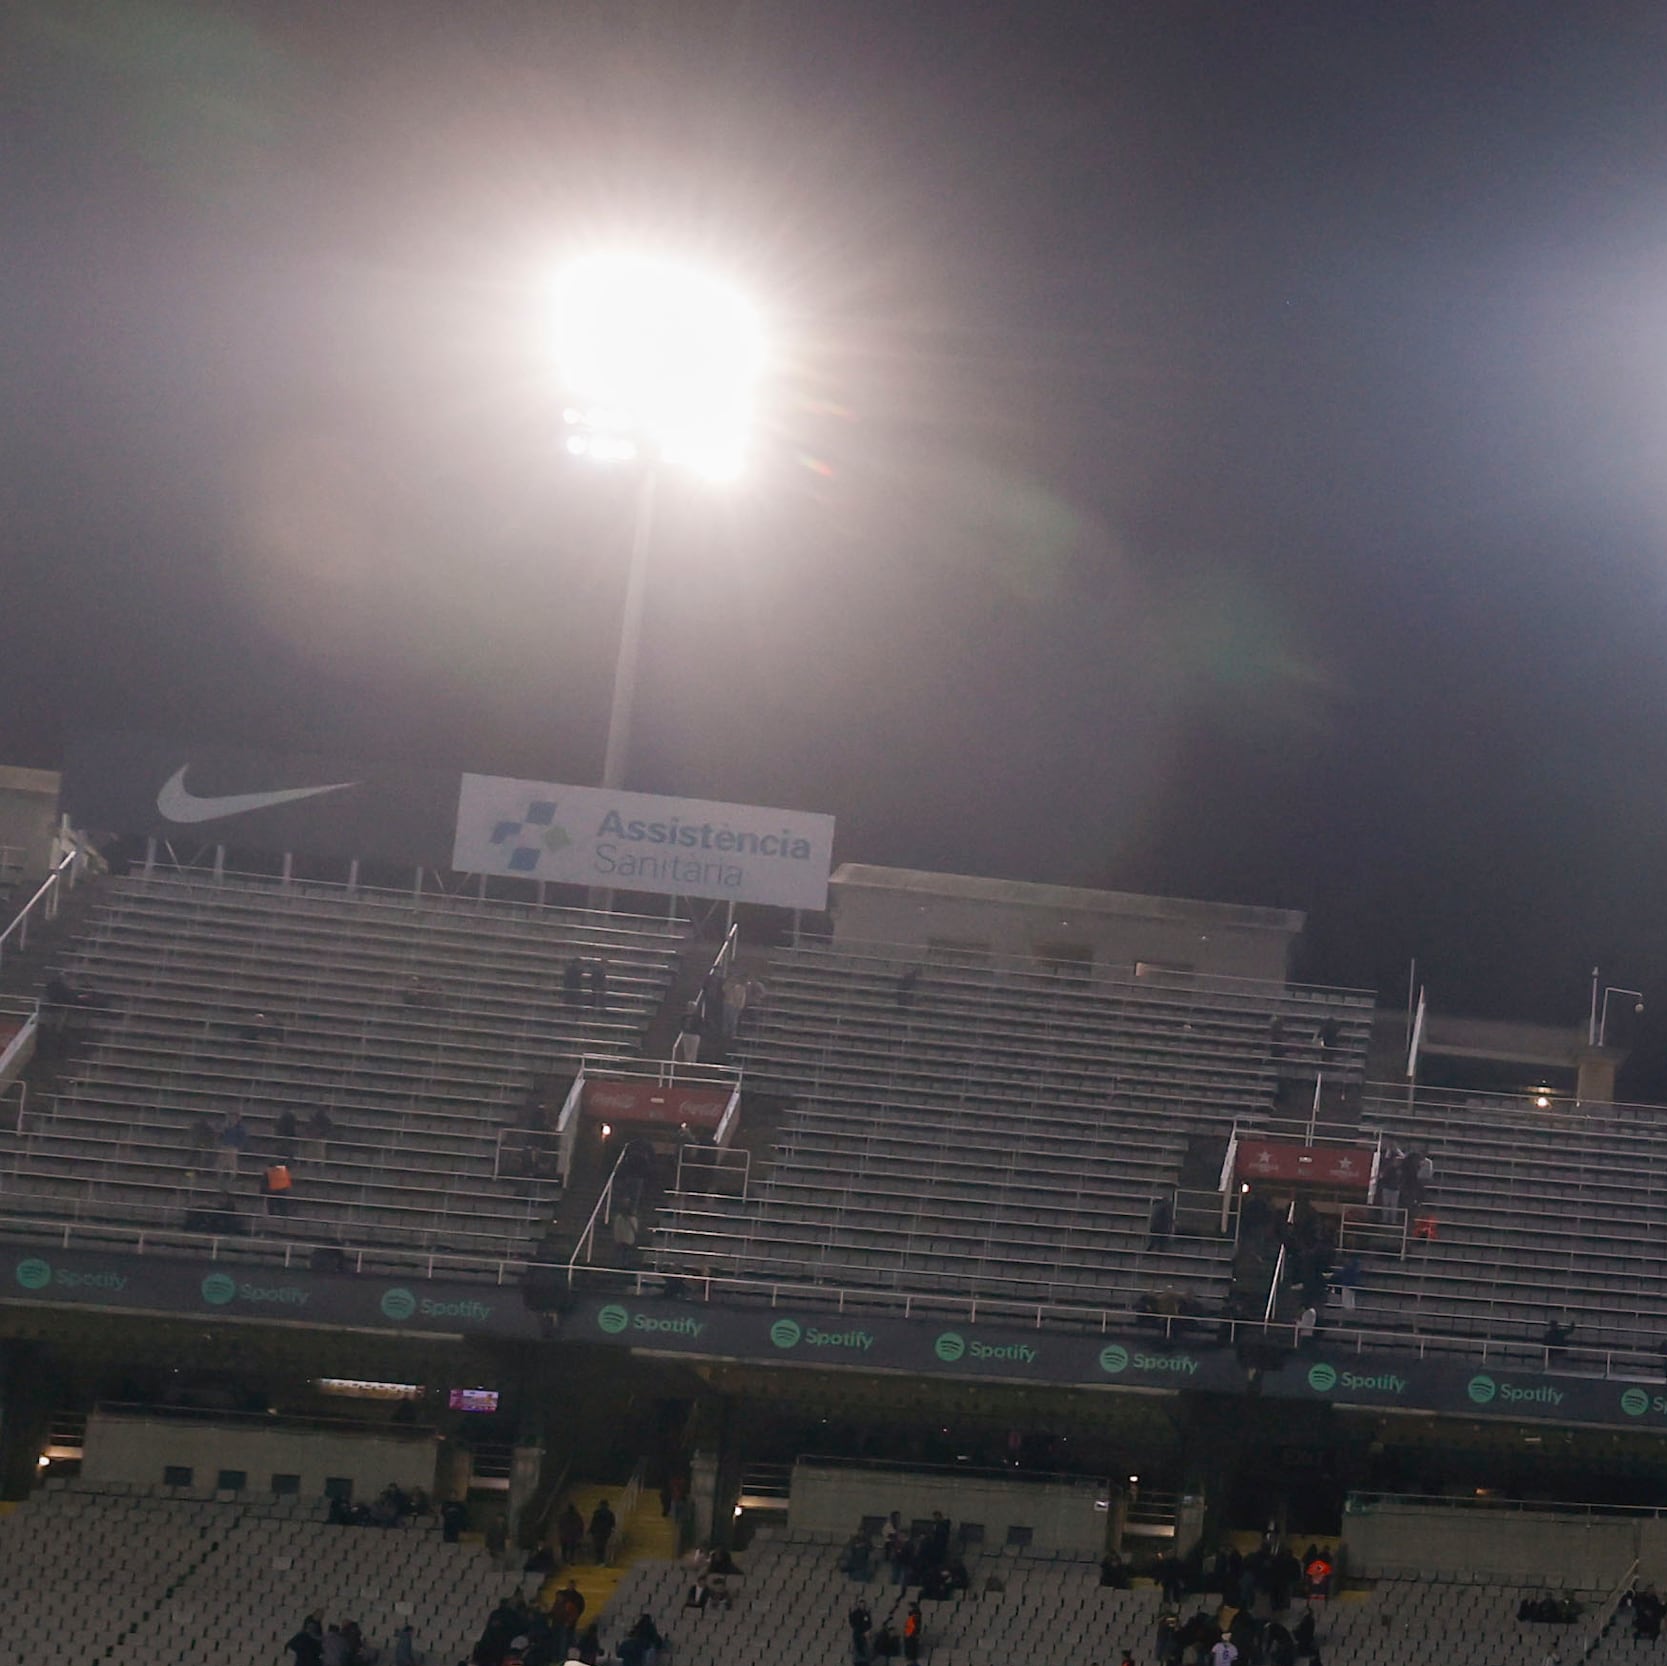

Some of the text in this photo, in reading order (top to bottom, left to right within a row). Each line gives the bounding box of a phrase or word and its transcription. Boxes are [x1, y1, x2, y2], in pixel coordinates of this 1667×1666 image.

[632, 1312, 704, 1337] Spotify
[805, 1326, 874, 1350] Spotify
[968, 1340, 1036, 1364] Spotify
[1132, 1352, 1199, 1375] Spotify
[1340, 1371, 1406, 1394] Spotify
[1500, 1382, 1563, 1405] Spotify
